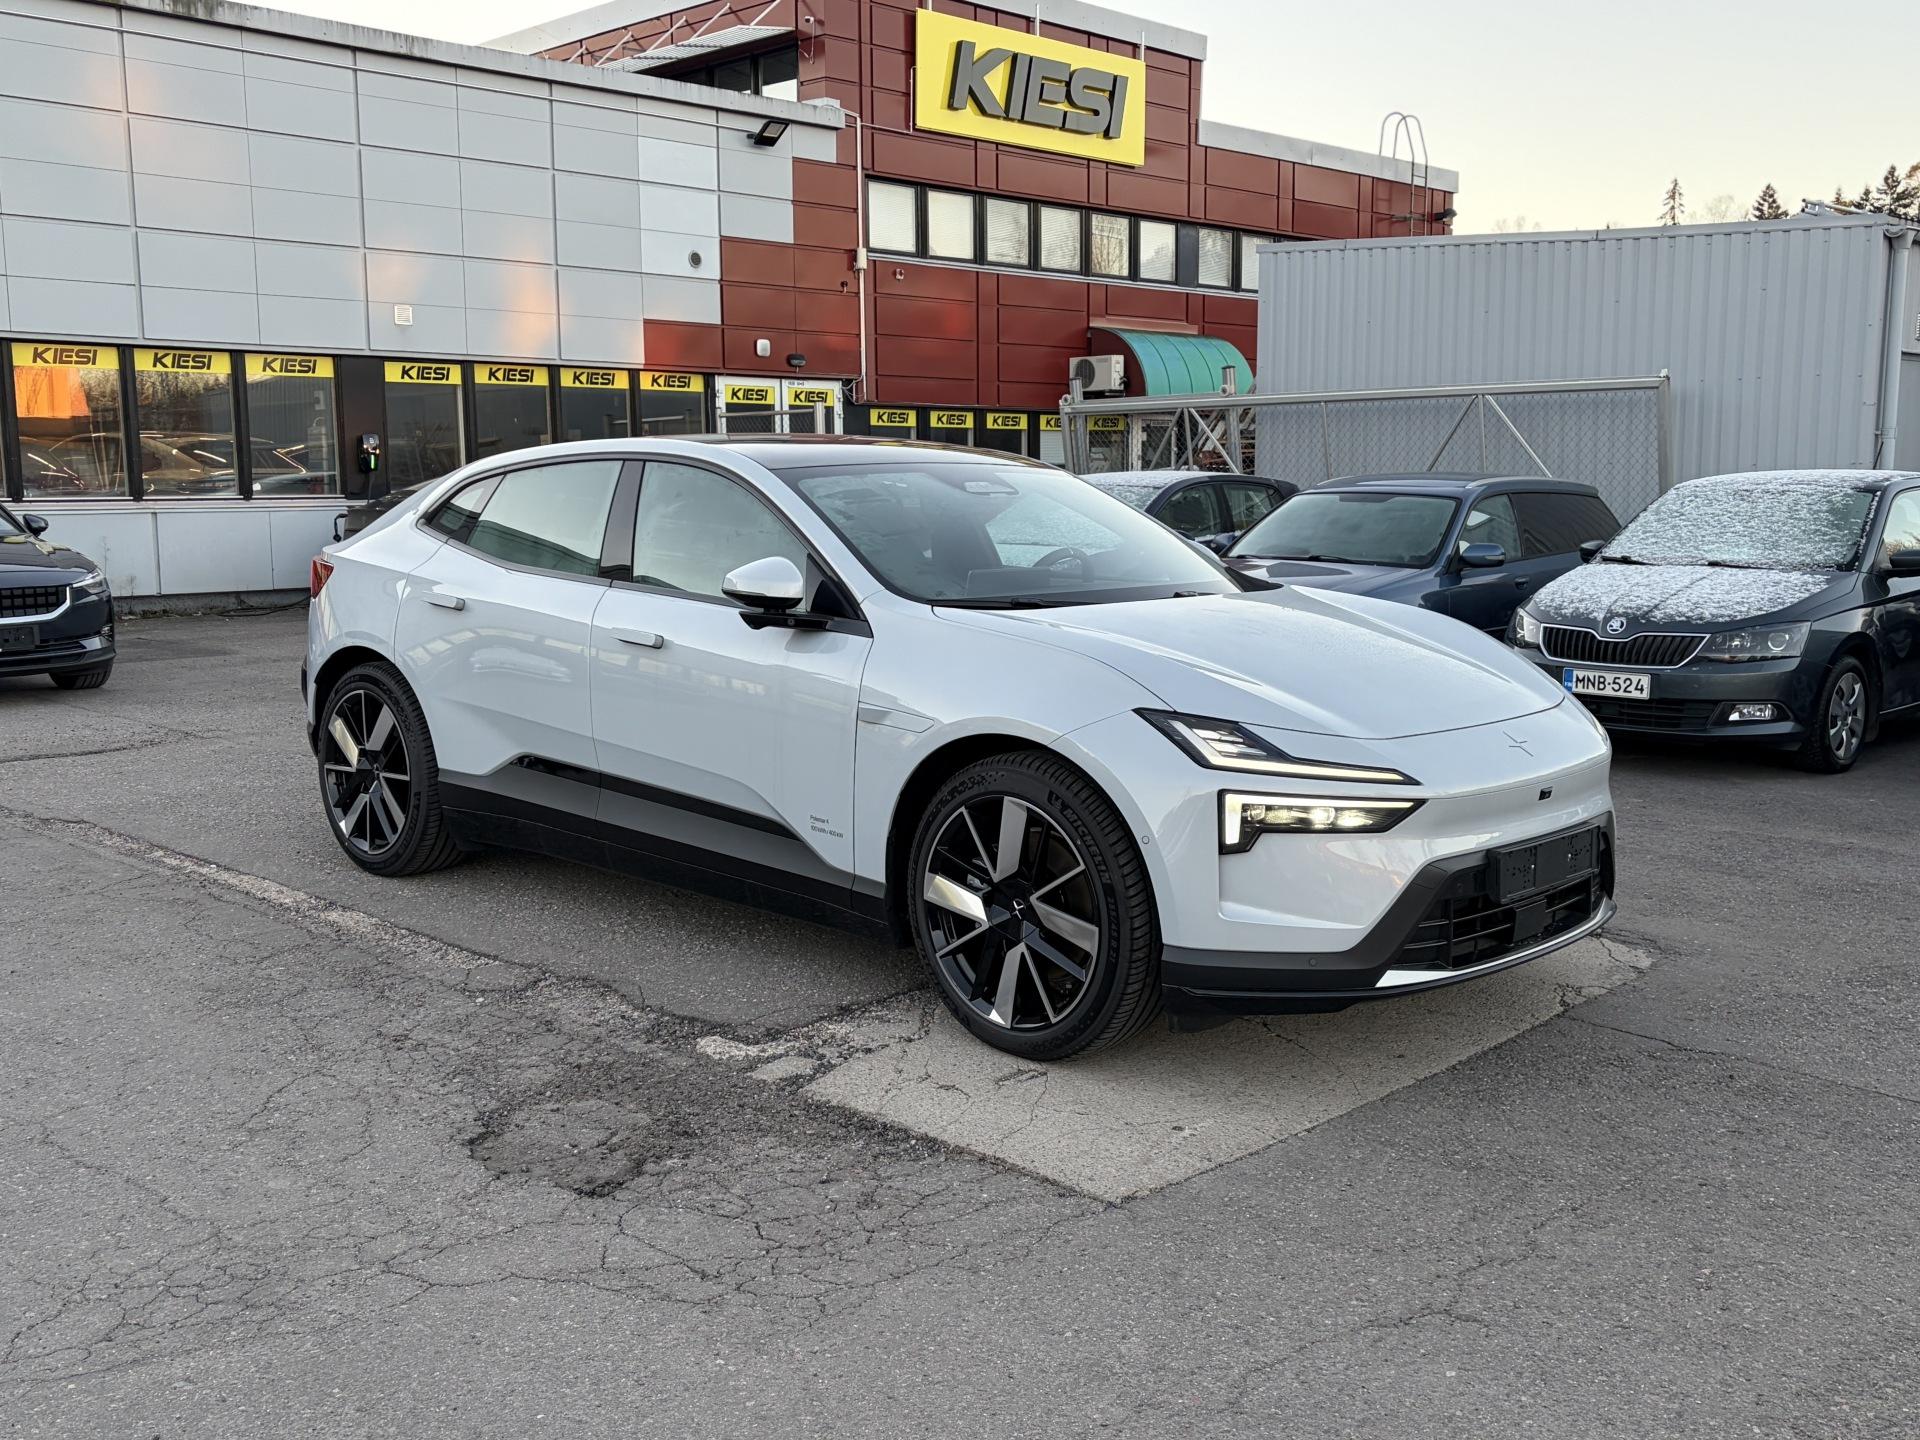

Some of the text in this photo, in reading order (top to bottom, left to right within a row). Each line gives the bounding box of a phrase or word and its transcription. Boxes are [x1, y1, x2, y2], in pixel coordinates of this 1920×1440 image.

[947, 39, 1129, 140] KIESI
[32, 347, 97, 365] KIESI
[152, 352, 212, 370] KIESI
[262, 357, 317, 374] KIESI
[401, 365, 450, 381] KIESI
[488, 367, 534, 383] KIESI
[572, 371, 615, 386] KIESI
[651, 374, 690, 389] KIESI
[731, 387, 768, 402] KIESI
[794, 390, 828, 403] KIESI
[877, 411, 909, 424] KIESI
[937, 413, 967, 426] KIESI
[992, 415, 1020, 427] KIESI
[1575, 674, 1645, 694] MNB-524
[1063, 807, 1111, 883] MICHELIN
